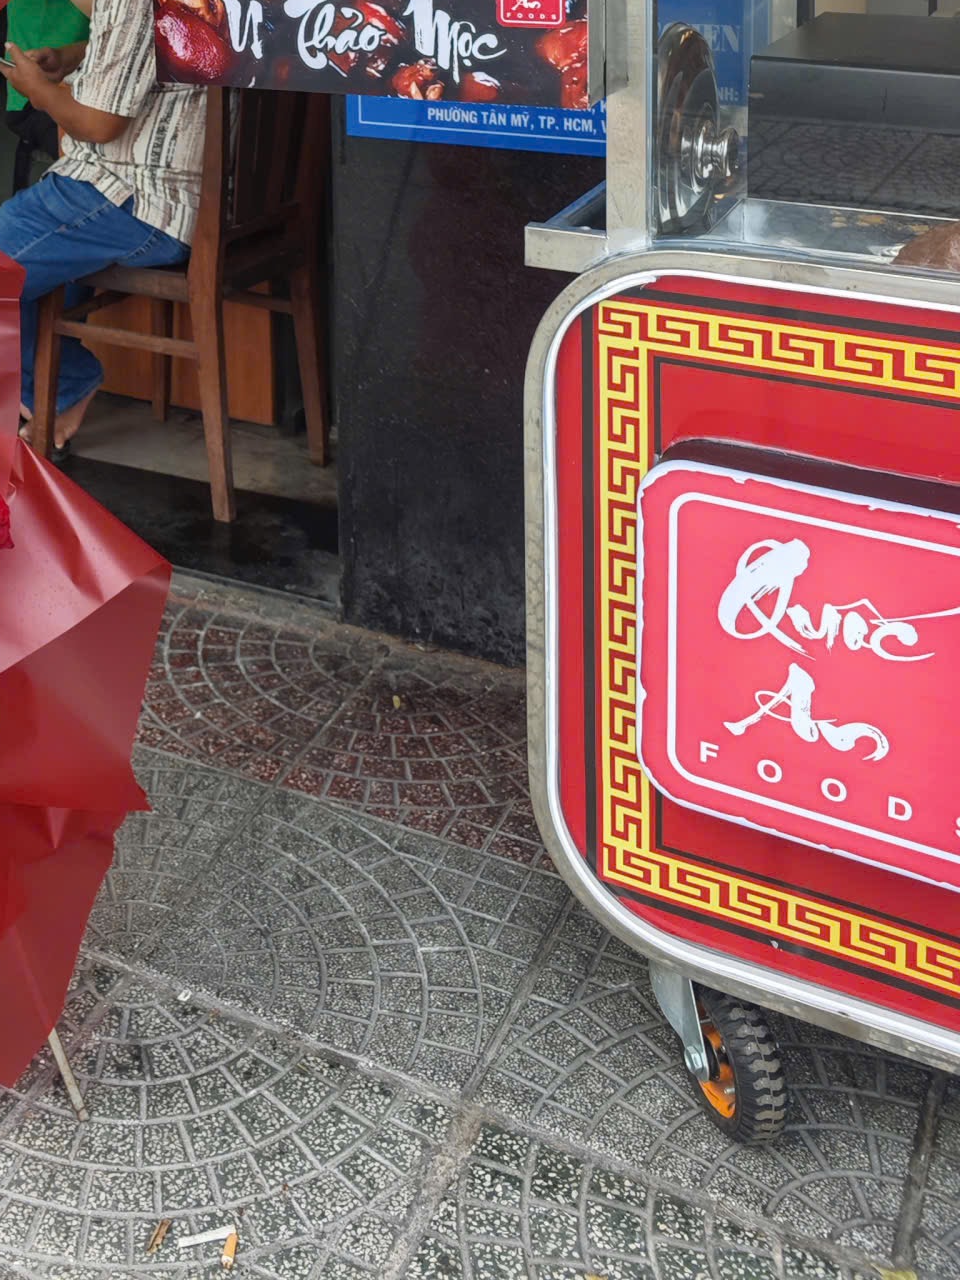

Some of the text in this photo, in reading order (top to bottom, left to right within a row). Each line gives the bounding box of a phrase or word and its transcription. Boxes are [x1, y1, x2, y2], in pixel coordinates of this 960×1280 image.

[506, 12, 557, 20] FOODS
[427, 106, 478, 125] PHƯỜNG
[481, 109, 507, 127] TÂN
[538, 115, 560, 131] TP.
[563, 117, 597, 136] HCM,
